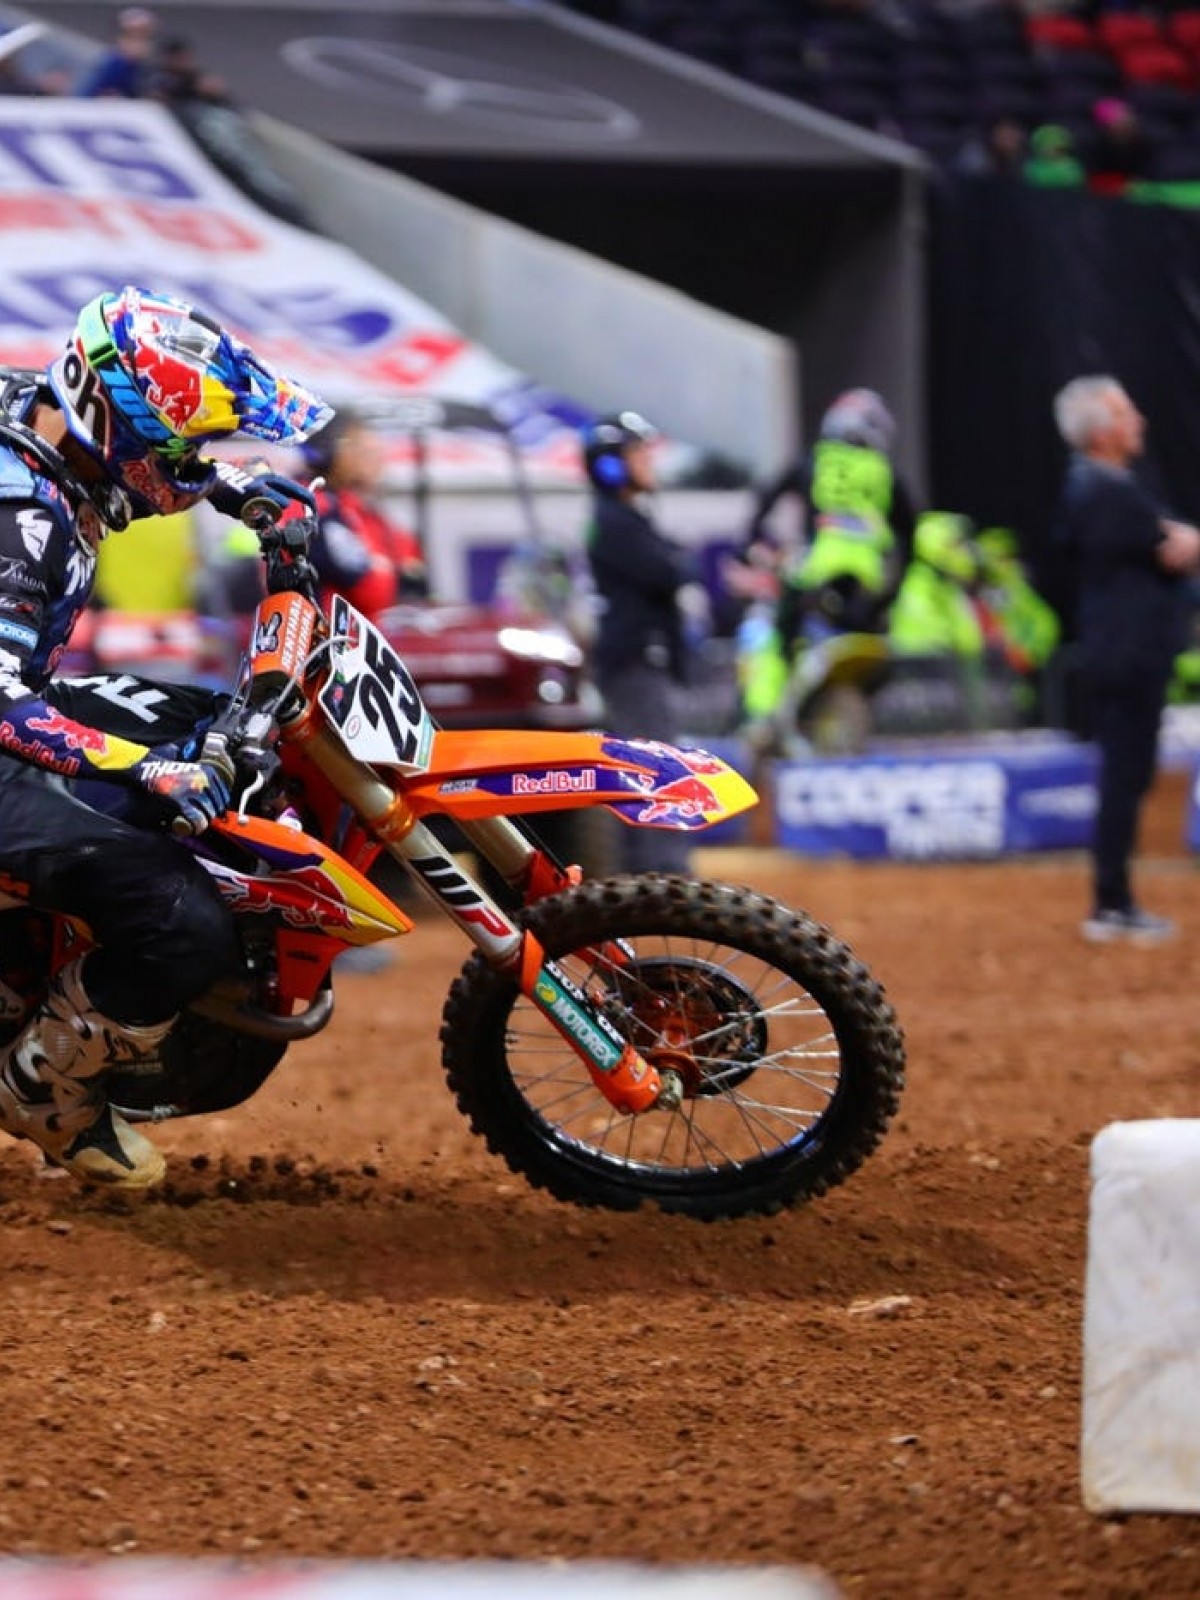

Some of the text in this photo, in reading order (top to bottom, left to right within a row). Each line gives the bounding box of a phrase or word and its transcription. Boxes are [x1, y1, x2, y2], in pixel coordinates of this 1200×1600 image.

[359, 626, 422, 765] 25
[512, 769, 596, 794] Red Bull
[551, 996, 618, 1068] MOTOREX
